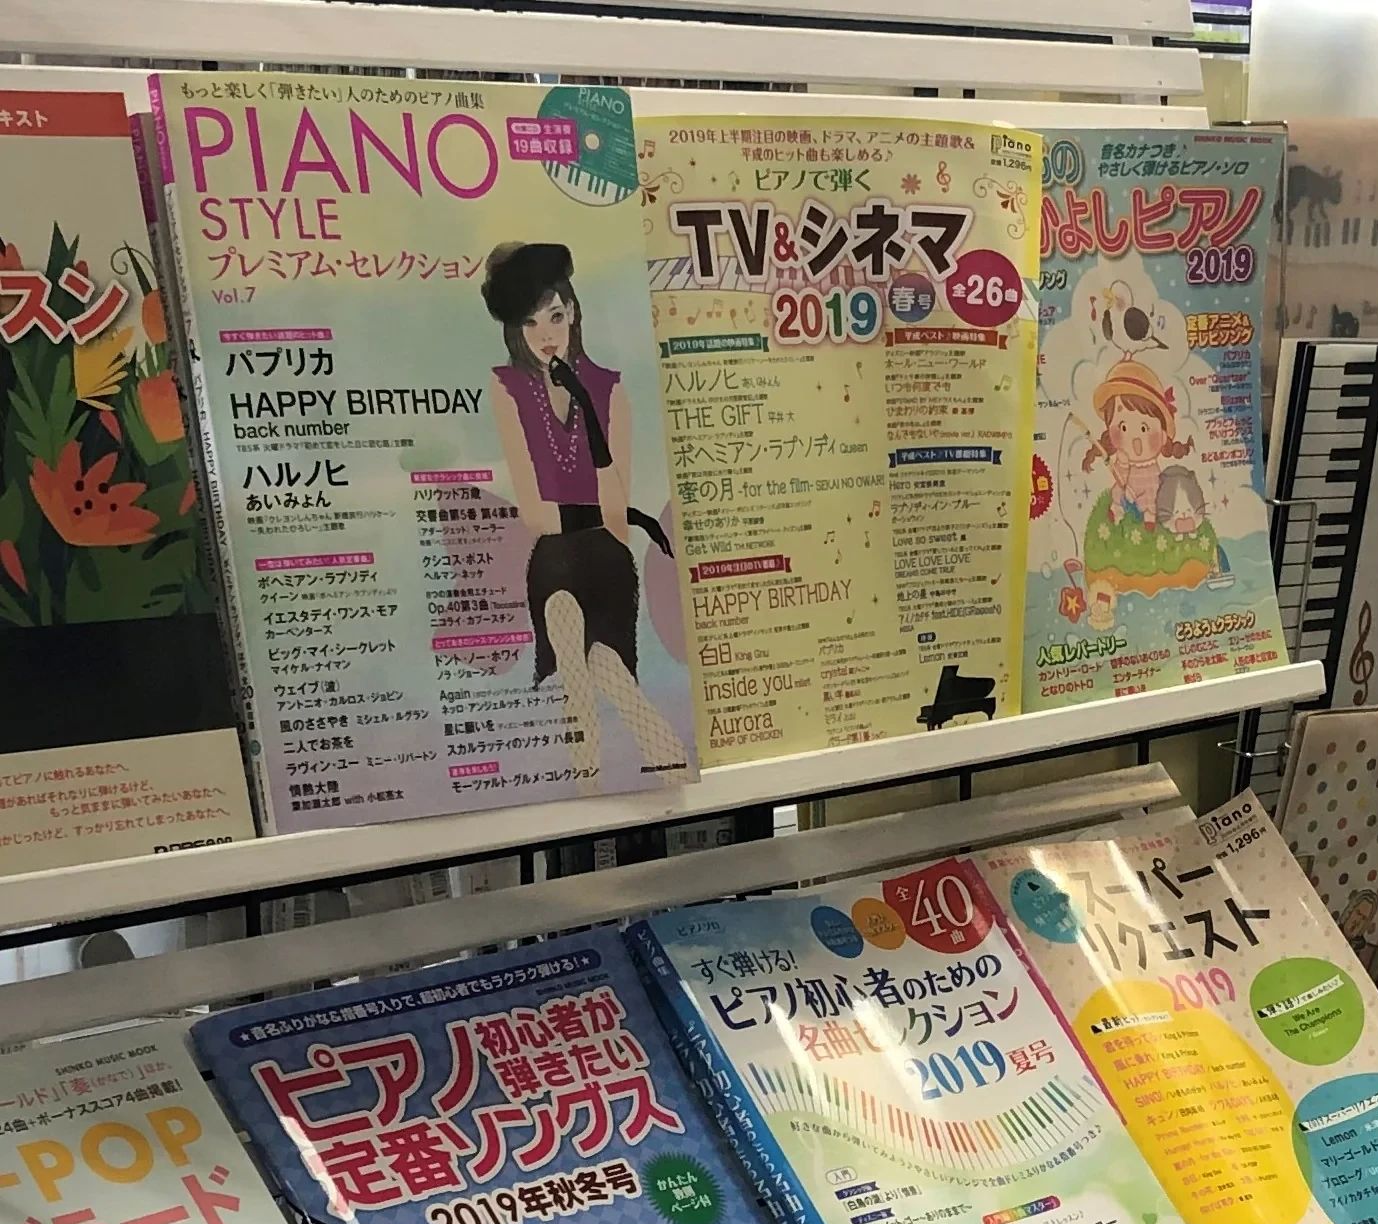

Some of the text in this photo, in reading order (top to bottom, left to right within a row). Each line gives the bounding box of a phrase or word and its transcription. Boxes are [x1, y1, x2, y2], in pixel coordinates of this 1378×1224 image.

[180, 82, 484, 110] もっと楽しく「弾きたい」人のためのピアノ曲集
[185, 106, 499, 199] PIANO
[755, 168, 873, 193] ピアノで弾く
[1098, 161, 1248, 177] やさしく弾けるピアノ・ソロ
[201, 198, 342, 242] STYLE
[674, 204, 968, 278] TV&シネマ
[208, 249, 483, 283] プレミアム・セレクション
[1187, 247, 1254, 283] 2019
[212, 286, 256, 304] Vol.7
[892, 287, 931, 312] 春号
[952, 274, 1019, 307] 全26曲
[775, 290, 879, 340] 2019
[1186, 312, 1250, 330] 定番アニメ&
[226, 347, 334, 376] パプリカ
[665, 369, 739, 393] ハルノヒ
[231, 388, 483, 419] HAPPY BIRTHDAY
[668, 403, 764, 430] THE GIFT
[235, 421, 350, 439] back number
[674, 433, 835, 467] ボヘミアン・ラプソディ
[243, 460, 349, 488] ハルノヒ
[246, 491, 331, 511] あいみょん
[677, 478, 734, 505] 蜜の月
[685, 541, 732, 556] Get Wild
[692, 579, 852, 618] HAPPY BIRTHDAY
[699, 642, 732, 666] 白日
[1037, 636, 1127, 668] 人気レパートリー
[1038, 663, 1102, 682] カントリー・ロード
[703, 674, 793, 701] inside you
[1040, 679, 1094, 697] となりのトトロ
[710, 712, 774, 737] Aurora
[1066, 856, 1214, 916] スーパー
[1079, 897, 1270, 972] リクエスト
[690, 949, 799, 986] すぐ弾ける!
[710, 953, 1002, 1031] ピアノ初心者のための
[1158, 965, 1236, 1012] 2019
[478, 990, 621, 1059] 初心者が
[1284, 1007, 1343, 1036] The Champions
[1293, 1008, 1321, 1022] We Are
[498, 1036, 644, 1096] 弾きたい
[904, 1039, 1059, 1102] 2019 夏号
[258, 1025, 475, 1140] ピアノ
[315, 1076, 681, 1209] 定番ソングス
[1322, 1128, 1358, 1148] Lemon
[1321, 1139, 1378, 1168] マリーゴールド
[834, 1169, 852, 1182] 入門
[1322, 1168, 1363, 1188] プロローグ
[1329, 1187, 1370, 1208] アイノカタチ
